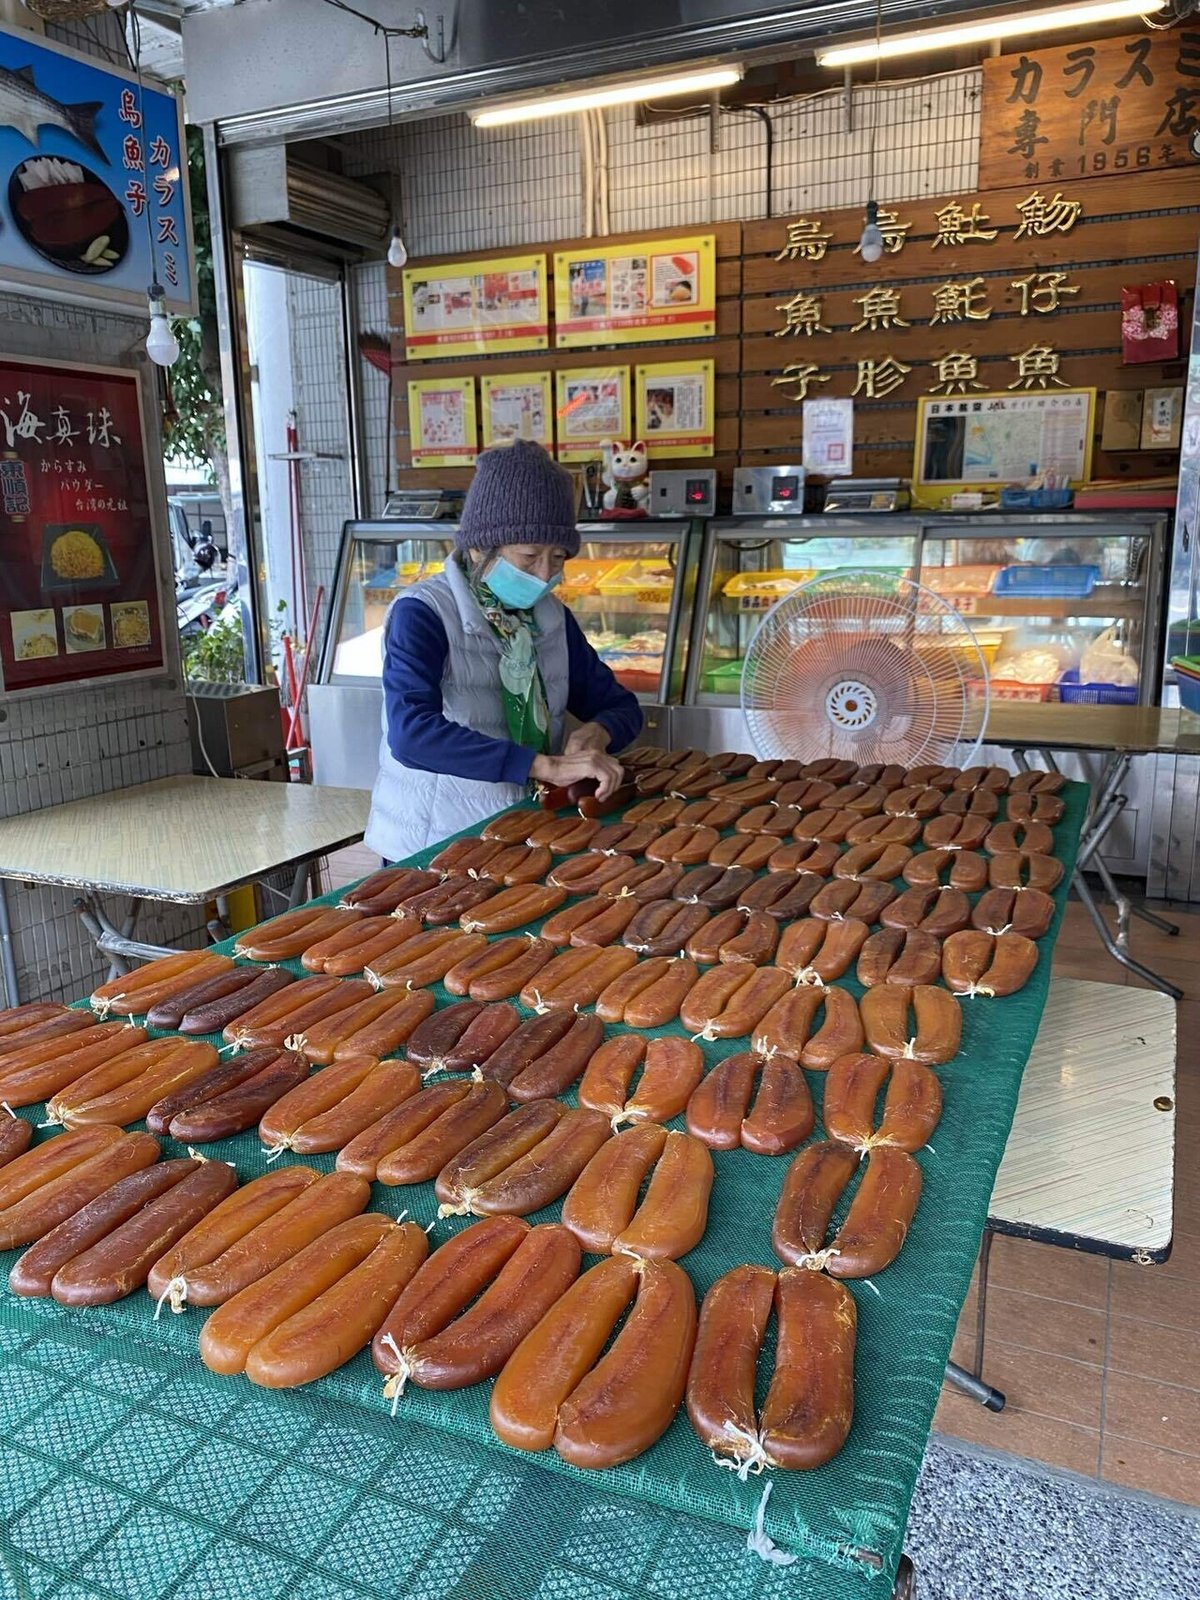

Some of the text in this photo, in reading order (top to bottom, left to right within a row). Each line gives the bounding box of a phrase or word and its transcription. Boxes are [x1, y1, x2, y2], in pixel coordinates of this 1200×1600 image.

[149, 135, 179, 285] カラスミ
[40, 459, 87, 473] からすみ
[60, 479, 104, 492] パウダー
